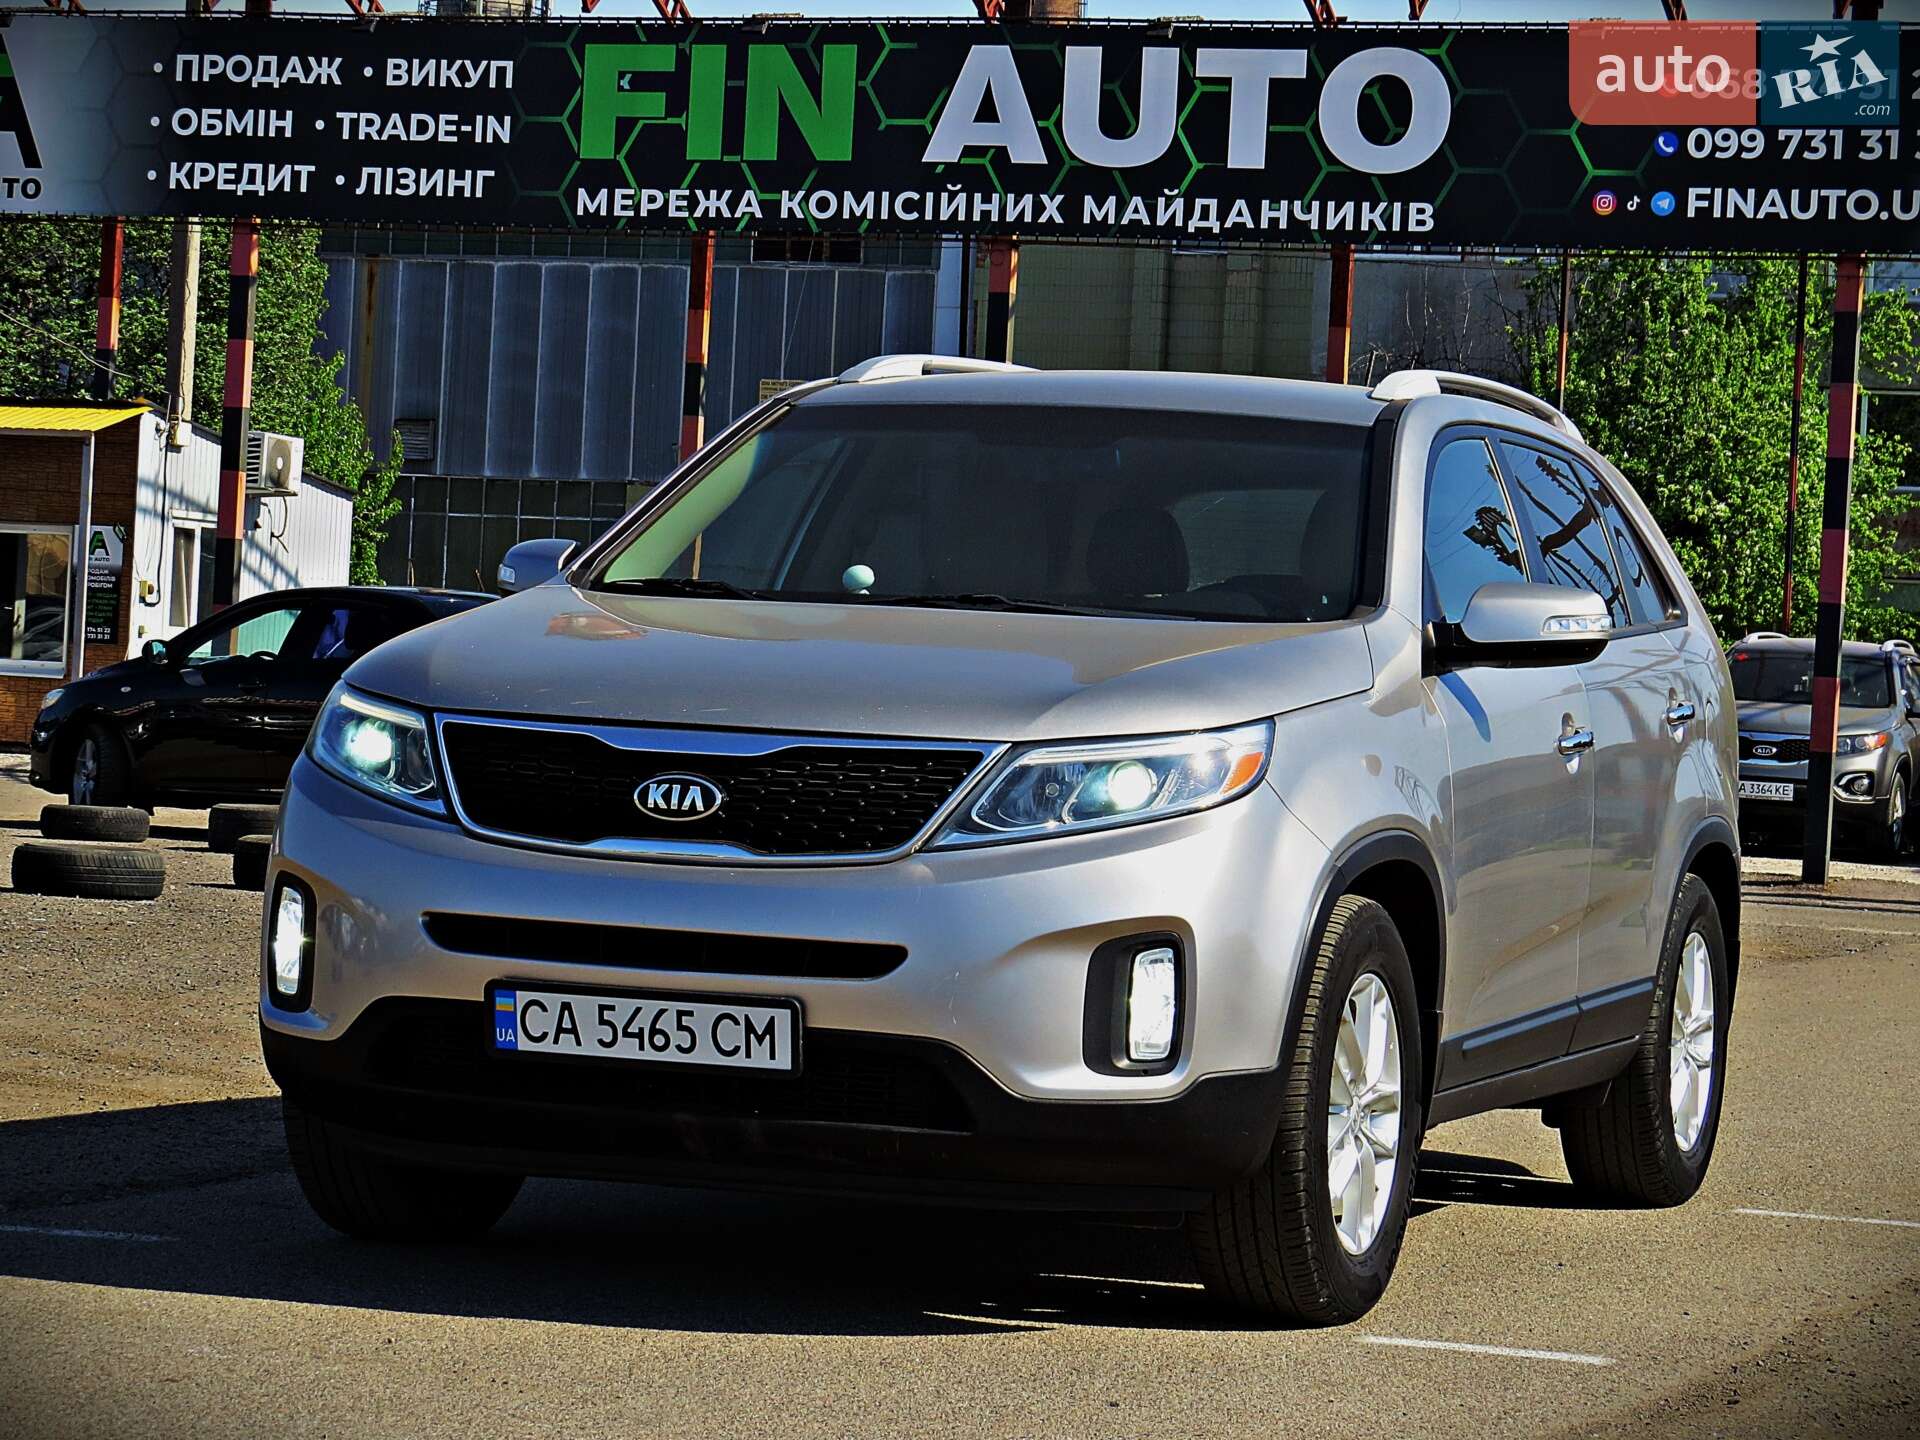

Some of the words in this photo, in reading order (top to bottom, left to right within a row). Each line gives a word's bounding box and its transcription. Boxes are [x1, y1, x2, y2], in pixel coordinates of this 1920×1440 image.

[175, 54, 342, 87] ПРОДАЖ
[386, 58, 514, 89] ВИКУП
[171, 108, 293, 137] ОБМІН
[336, 112, 511, 144] TRADE-IN
[580, 44, 858, 161] FIN
[921, 45, 1452, 174] AUTO
[1687, 128, 1765, 160] 099
[1778, 129, 1843, 160] 731
[1858, 129, 1900, 160] 31
[169, 162, 316, 196] КРЕДИТ
[356, 167, 495, 198] ЛІЗИНГ
[577, 187, 763, 218] МЕРЕЖА
[780, 184, 1064, 224] КОМІСІЙНИХ
[1083, 188, 1434, 232] МАЙДАНЧИКІВ
[1687, 187, 1920, 221] FINAUTO.U
[647, 783, 704, 811] KIA
[1749, 783, 1773, 795] 3364
[1775, 785, 1790, 796] KE
[496, 1028, 516, 1043] UA
[519, 999, 582, 1047] CA
[597, 1003, 697, 1055] 5465
[711, 1012, 776, 1061] CM
